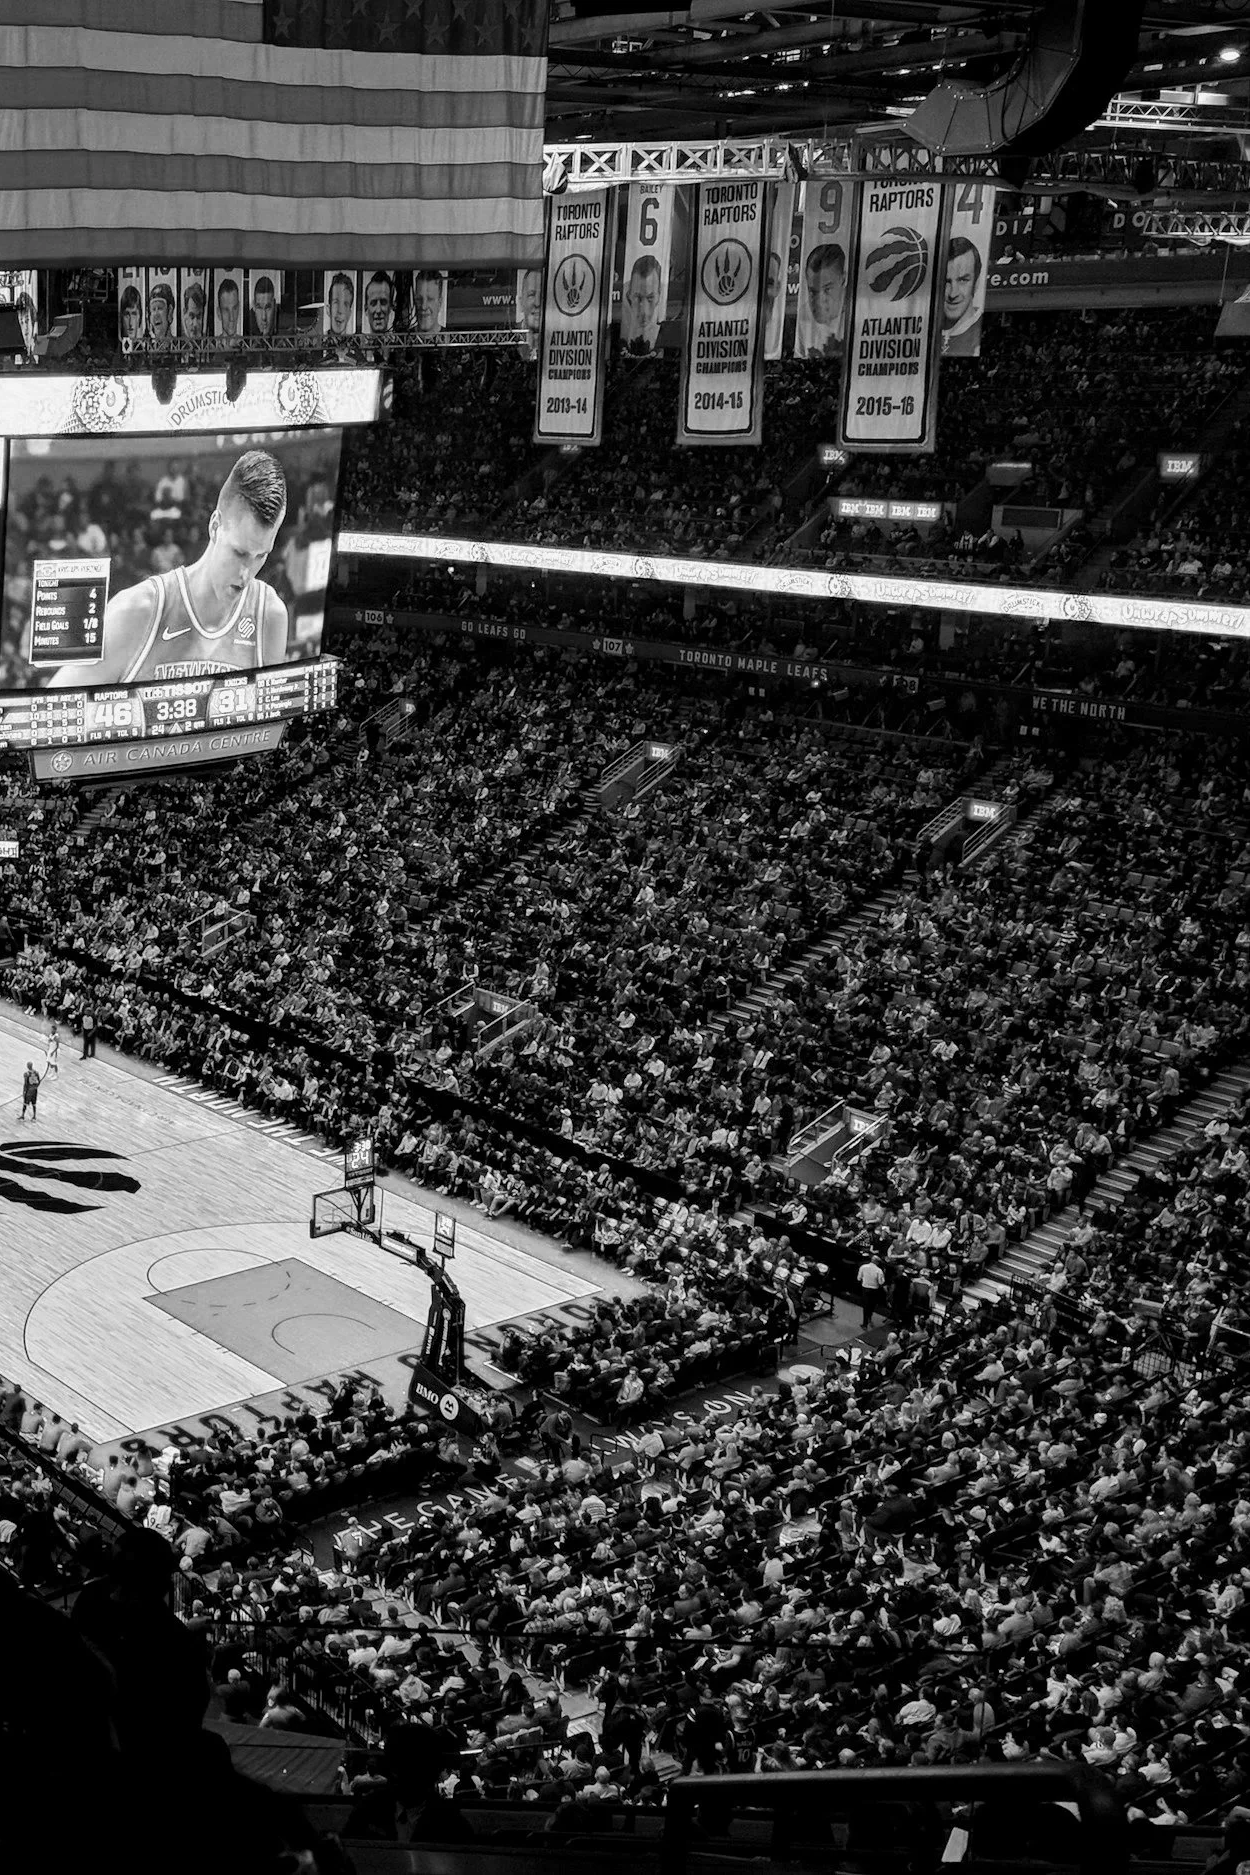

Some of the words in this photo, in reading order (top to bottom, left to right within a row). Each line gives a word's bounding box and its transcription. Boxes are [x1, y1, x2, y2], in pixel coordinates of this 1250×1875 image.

[705, 182, 758, 205] TORONTO
[869, 188, 934, 213] RAPTORS
[557, 203, 601, 221] TORONTO
[818, 181, 843, 234] 9
[957, 183, 984, 224] 4
[639, 198, 660, 246] 6
[703, 203, 757, 226] RAPTORS
[555, 222, 600, 241] RAPTORS
[861, 316, 923, 337] ATLANTIC
[550, 330, 593, 347] ATLANTIC
[549, 349, 592, 366] DIVISION
[697, 339, 749, 359] DIVISION
[859, 338, 921, 360] DIVISION
[548, 368, 591, 380] CHAMPIONS
[696, 359, 748, 374] CHAMPIONS
[857, 362, 919, 377] CHAMPIONS
[547, 397, 588, 414] 2013-14
[694, 391, 744, 410] 2014-15
[855, 396, 915, 416] 2015-16
[1167, 460, 1194, 473] IBM
[842, 502, 859, 514] IBM
[865, 504, 885, 516] IBM
[892, 505, 911, 517] IBM
[917, 506, 937, 518] IBM
[89, 588, 97, 599] 4
[88, 603, 96, 614] 2
[365, 612, 384, 623] 106
[84, 632, 97, 644] 15
[461, 620, 474, 632] GO
[478, 624, 508, 638] LEAFS
[513, 628, 527, 640] GO
[604, 640, 622, 652] 107
[679, 649, 732, 668] TORONTO
[737, 656, 778, 674] MAPLE
[787, 663, 828, 680] LEAFS
[93, 690, 129, 701] RAPTORS
[218, 687, 248, 714] 31
[94, 702, 132, 728] 46
[156, 698, 197, 720] 3:38
[1032, 695, 1047, 710] WE
[1051, 698, 1076, 715] THE
[1080, 702, 1126, 720] NORTH
[151, 724, 165, 736] 24
[184, 721, 192, 732] 2
[83, 751, 117, 766] AIR
[126, 740, 202, 762] CANADA
[209, 730, 271, 751] CENTRE
[152, 1074, 262, 1118] NORTH
[246, 1116, 315, 1146] THE
[351, 1150, 369, 1169] 24
[415, 1382, 439, 1405] BMO
